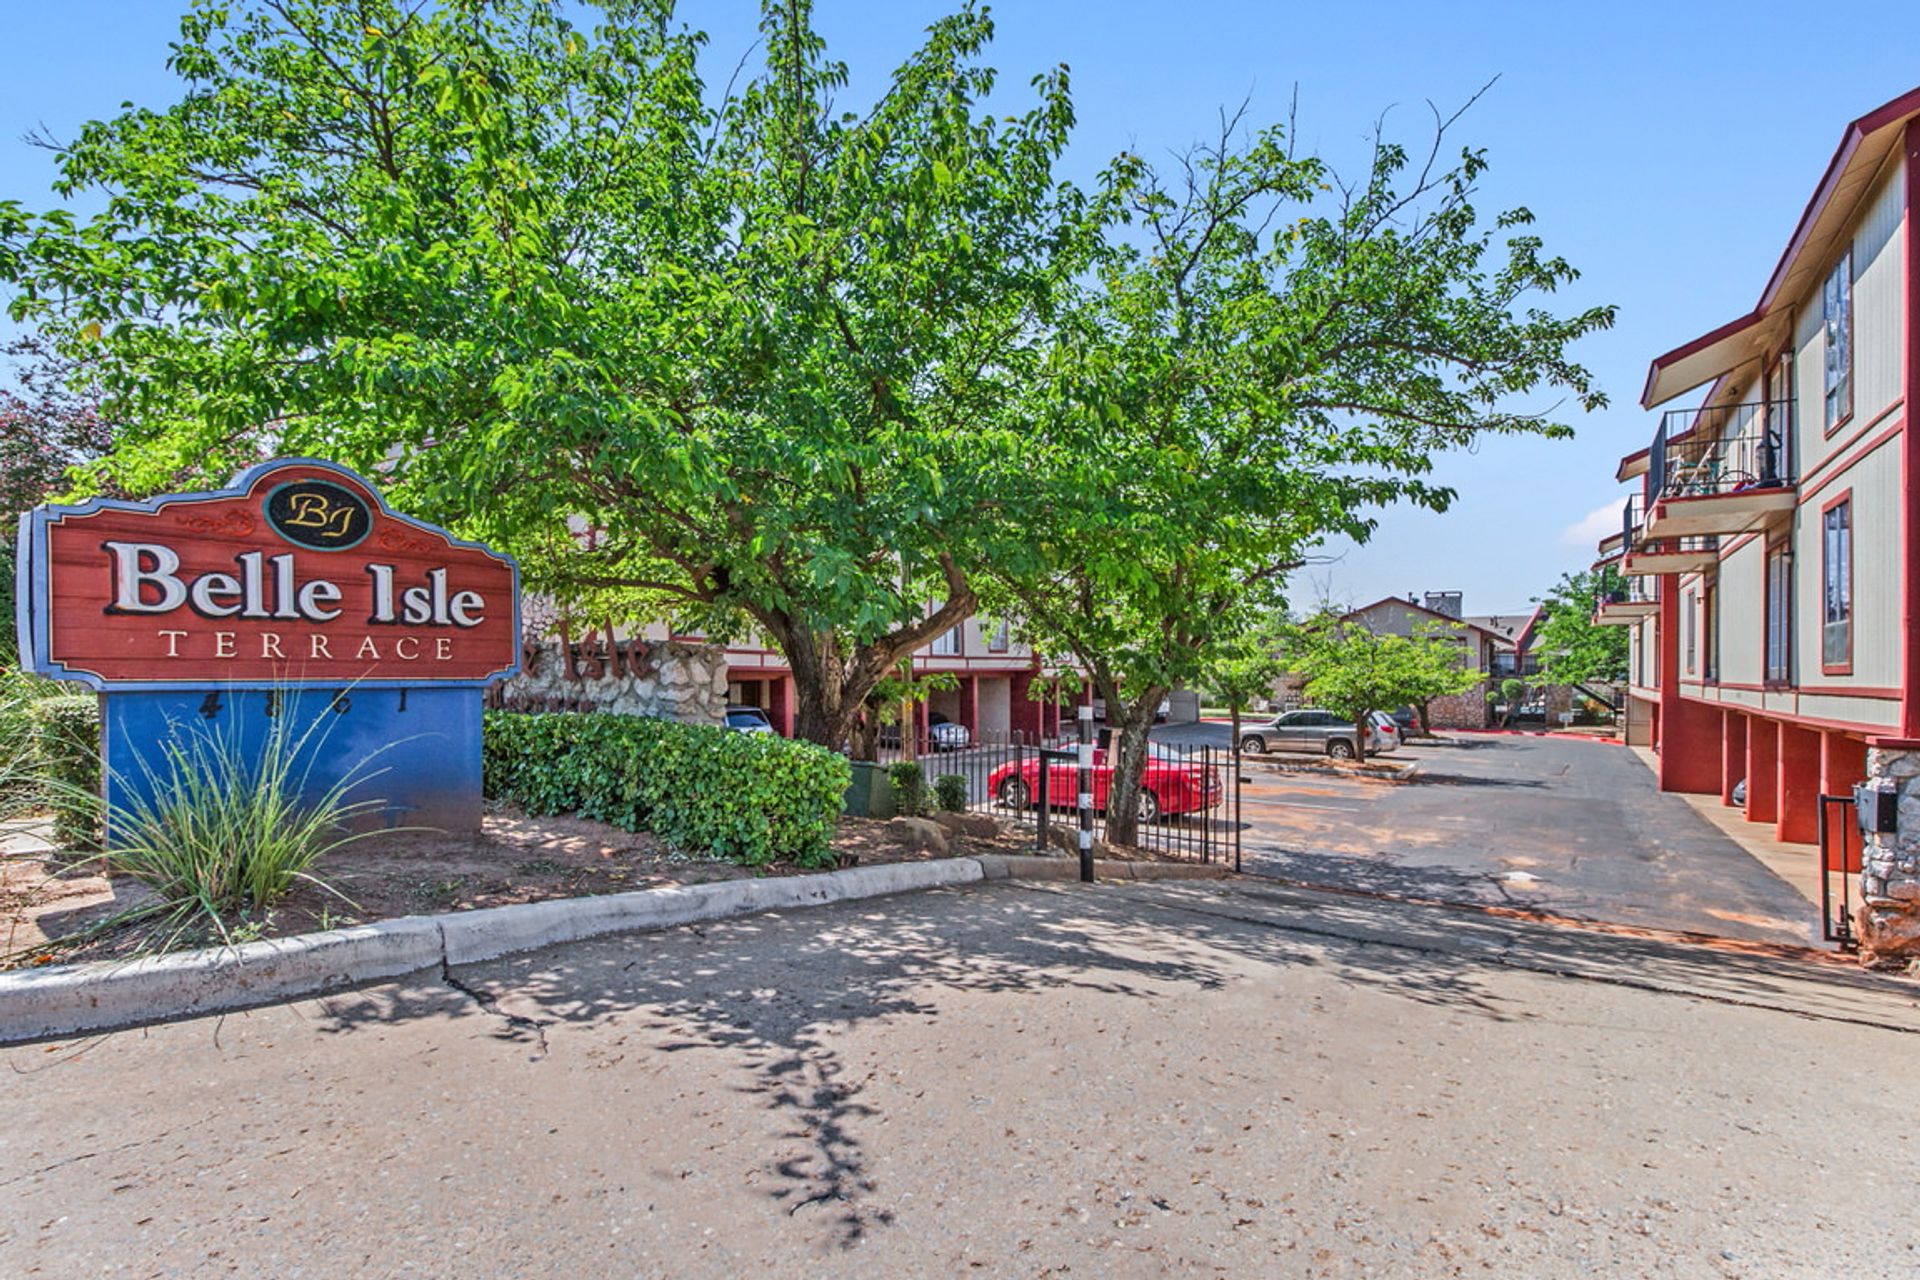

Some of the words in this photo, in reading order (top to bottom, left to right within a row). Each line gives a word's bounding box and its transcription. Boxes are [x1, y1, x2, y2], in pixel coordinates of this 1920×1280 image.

[103, 540, 342, 625] Belle
[367, 563, 485, 628] Isle
[158, 630, 454, 660] TERRACE
